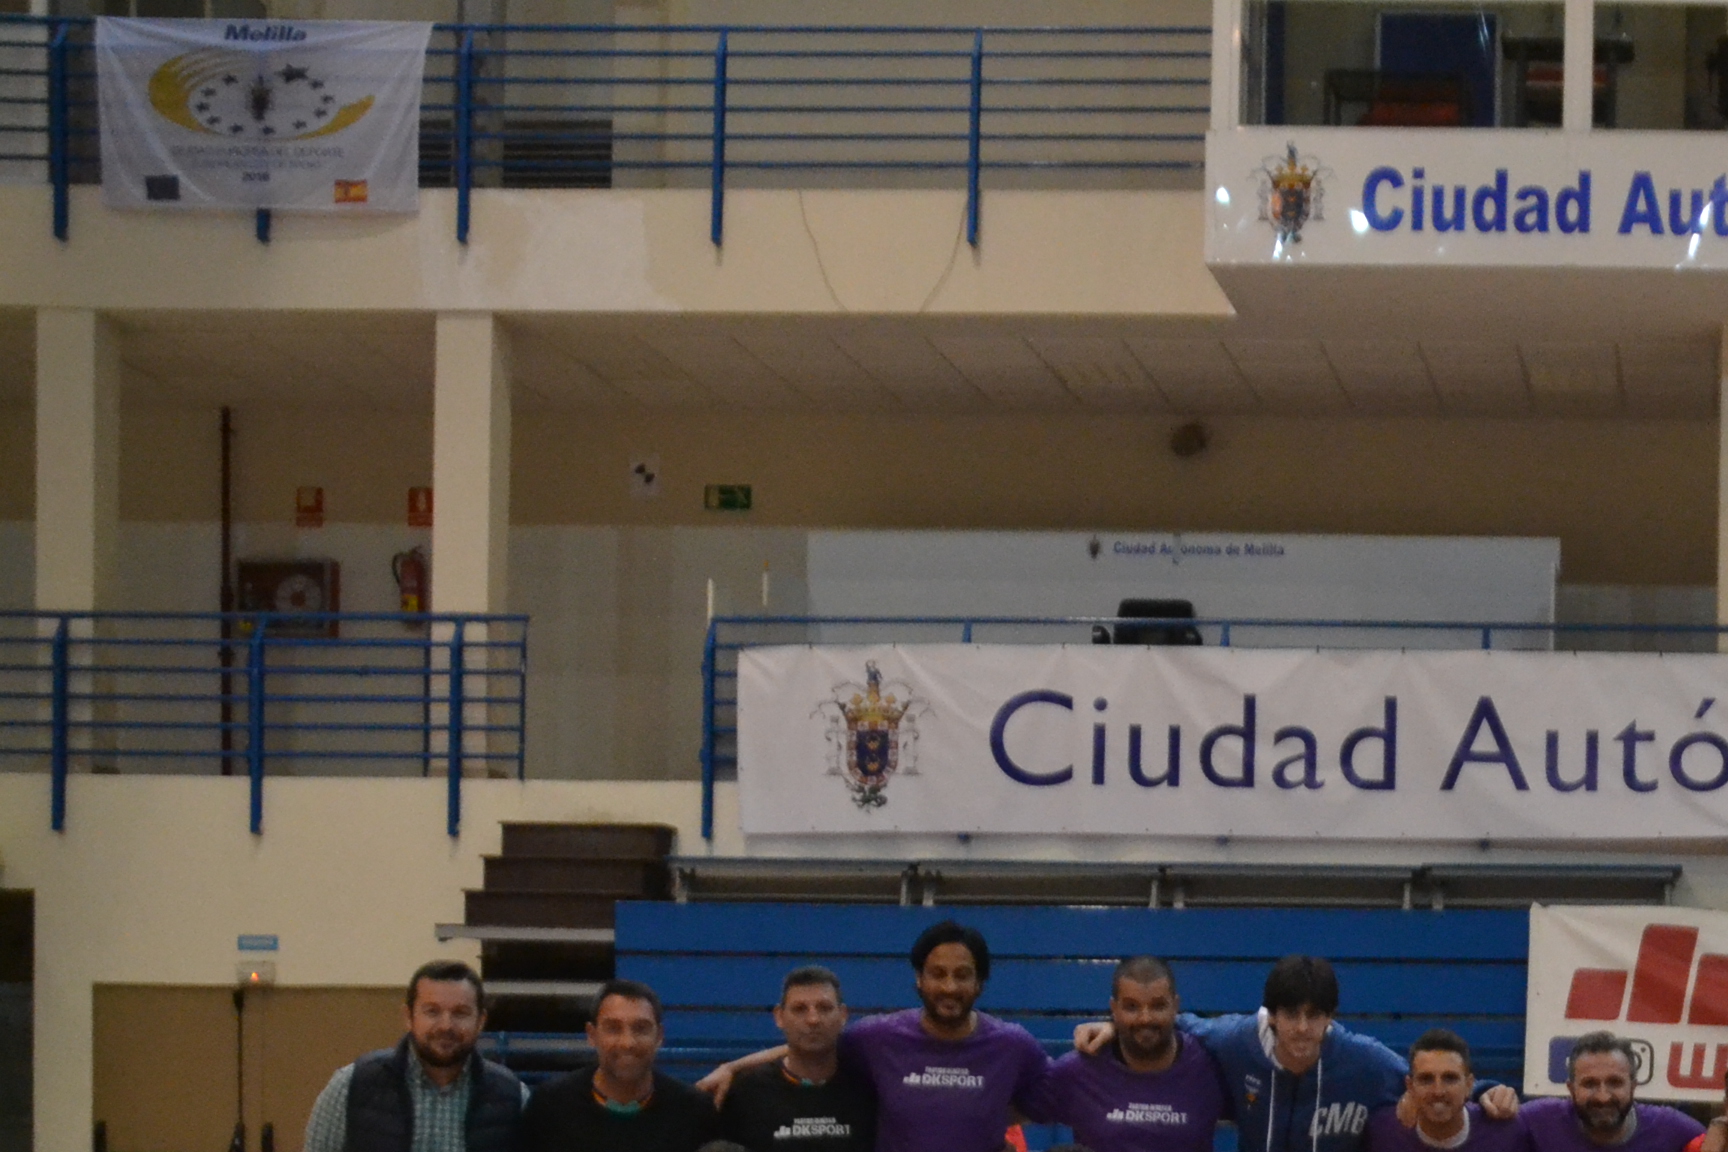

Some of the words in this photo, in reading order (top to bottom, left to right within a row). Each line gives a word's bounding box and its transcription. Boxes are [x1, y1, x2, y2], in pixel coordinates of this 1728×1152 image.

[223, 24, 308, 42] Melilla
[1362, 166, 1591, 234] Ciudad
[987, 688, 1398, 791] Ciudad
[921, 1075, 984, 1087] DKSPORT
[1125, 1111, 1187, 1125] DKSPORT
[1309, 1102, 1368, 1137] CMB
[792, 1124, 850, 1137] DKSPORT
